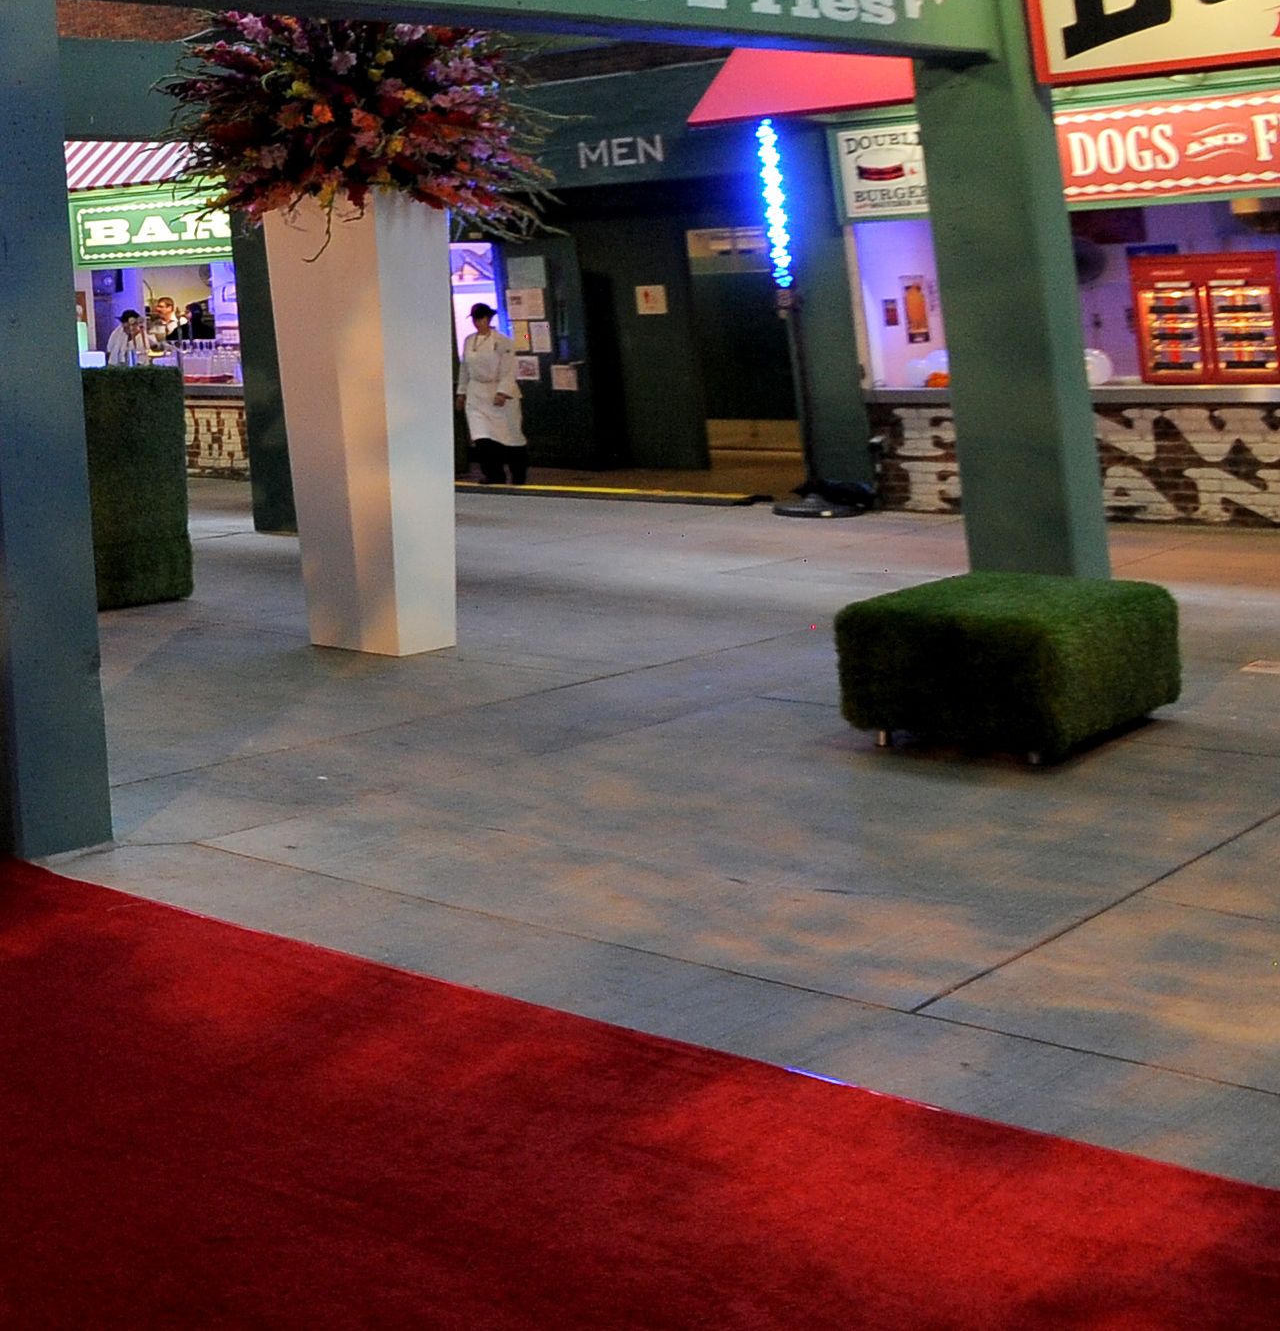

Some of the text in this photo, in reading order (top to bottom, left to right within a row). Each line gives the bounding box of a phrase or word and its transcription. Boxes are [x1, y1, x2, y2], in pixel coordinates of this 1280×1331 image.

[577, 134, 664, 169] MEN
[1068, 123, 1181, 177] DOGS
[1185, 129, 1248, 157] AND
[84, 211, 232, 247] BAR
